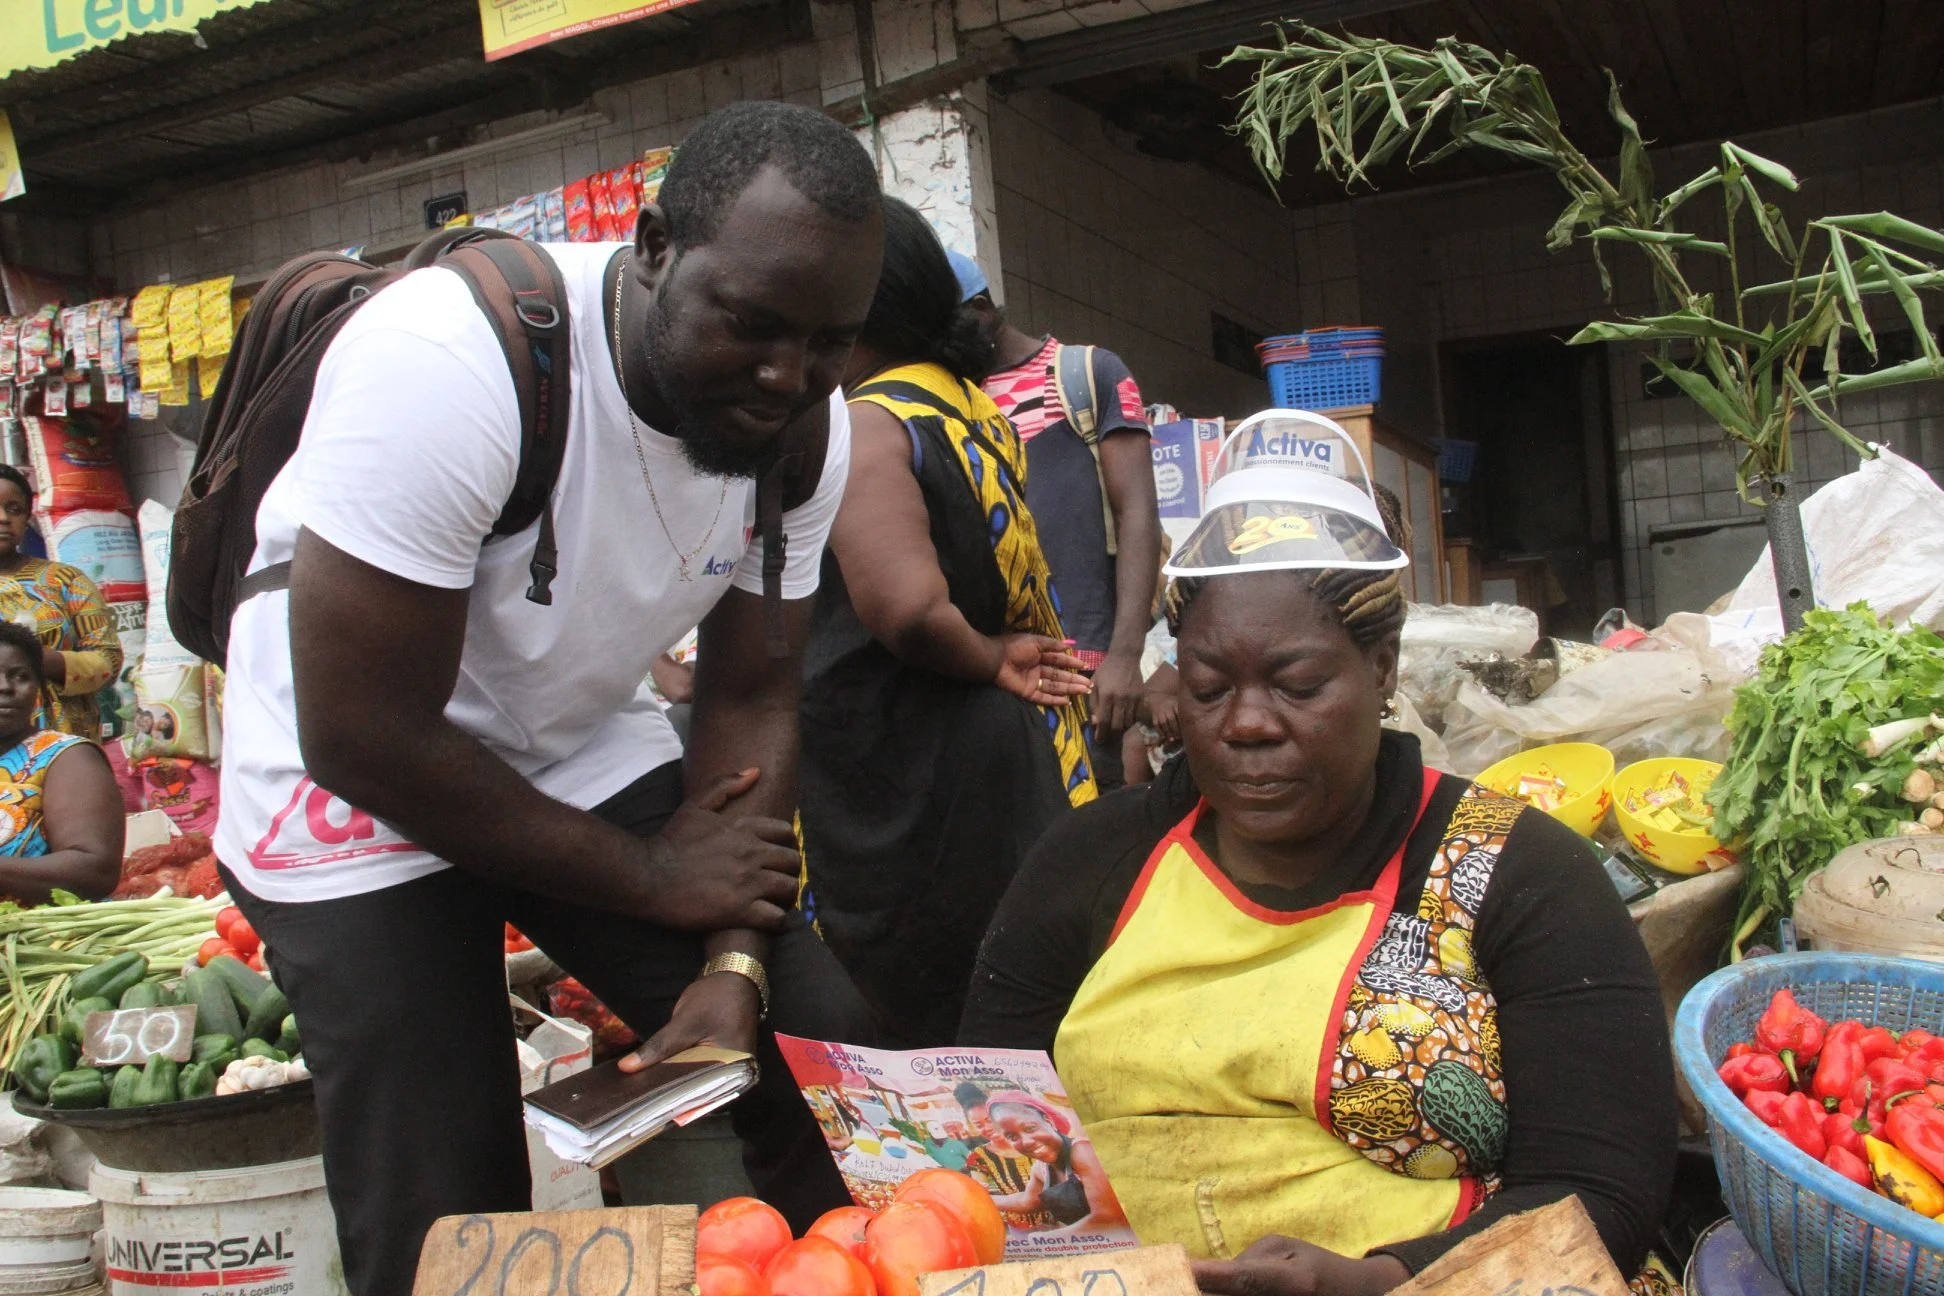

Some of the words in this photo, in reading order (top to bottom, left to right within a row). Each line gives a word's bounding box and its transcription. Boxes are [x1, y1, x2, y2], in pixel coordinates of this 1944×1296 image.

[1246, 426, 1331, 462] Activa
[1306, 461, 1330, 472] clients
[825, 1050, 867, 1064] ACTIVA
[936, 1055, 985, 1066] ACTIVA
[857, 1063, 884, 1076] Asso
[938, 1067, 969, 1077] Mon
[973, 1066, 1004, 1075] Asso
[550, 1163, 584, 1182] QUALIT
[1004, 1239, 1030, 1248] vec
[1032, 1236, 1066, 1246] Mon
[1070, 1234, 1111, 1244] Asso,
[1044, 1243, 1080, 1253] double
[1081, 1240, 1136, 1252] protection
[106, 1231, 294, 1272] UNIVERSAL
[456, 1214, 635, 1296] 200
[249, 1281, 294, 1296] coatings
